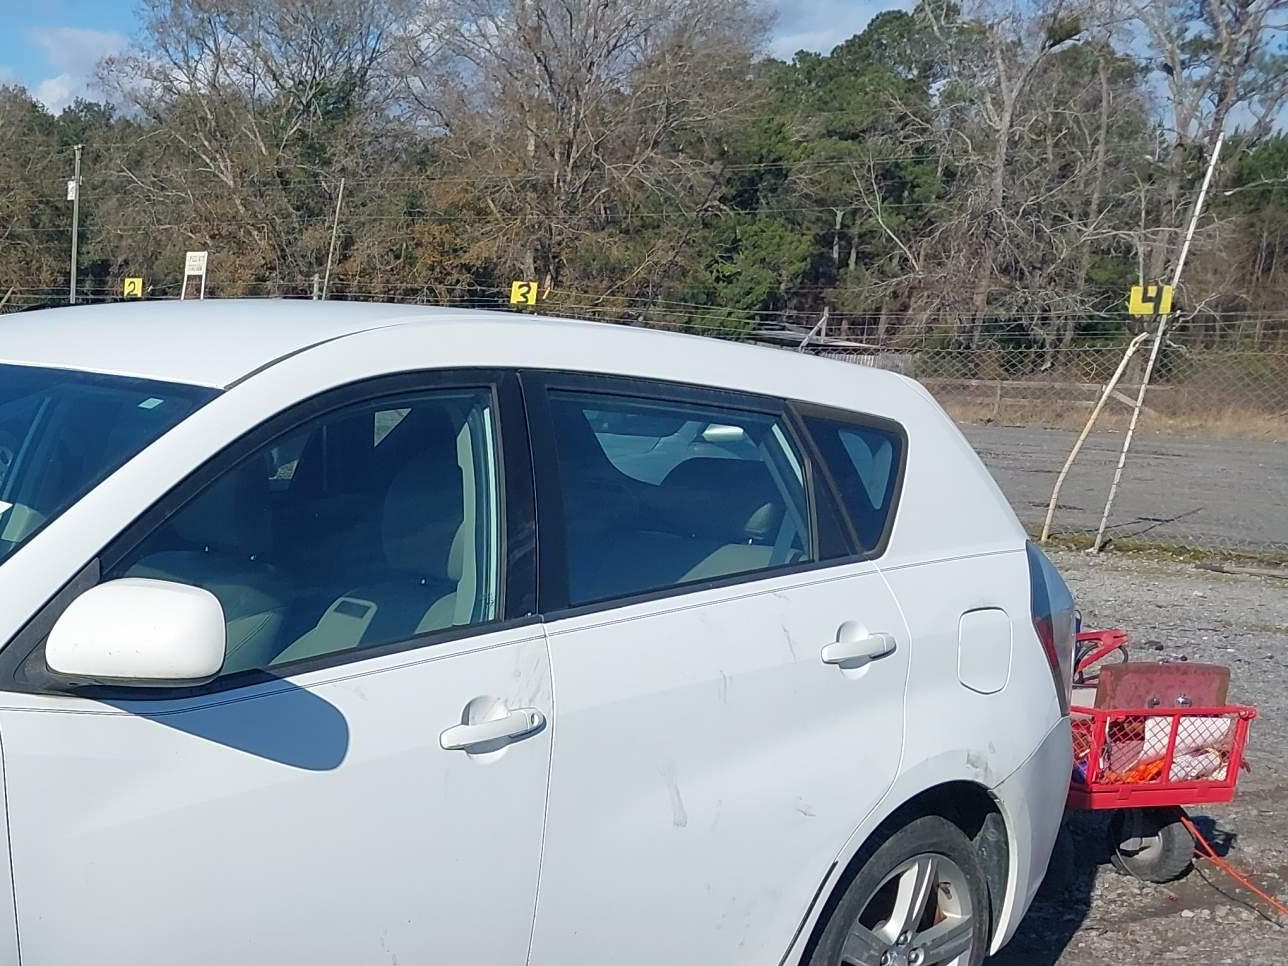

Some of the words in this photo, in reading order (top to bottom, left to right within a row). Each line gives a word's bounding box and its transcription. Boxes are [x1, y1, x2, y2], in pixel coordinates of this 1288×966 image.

[126, 281, 138, 297] 2
[517, 282, 531, 303] 3
[1142, 285, 1164, 315] 4
